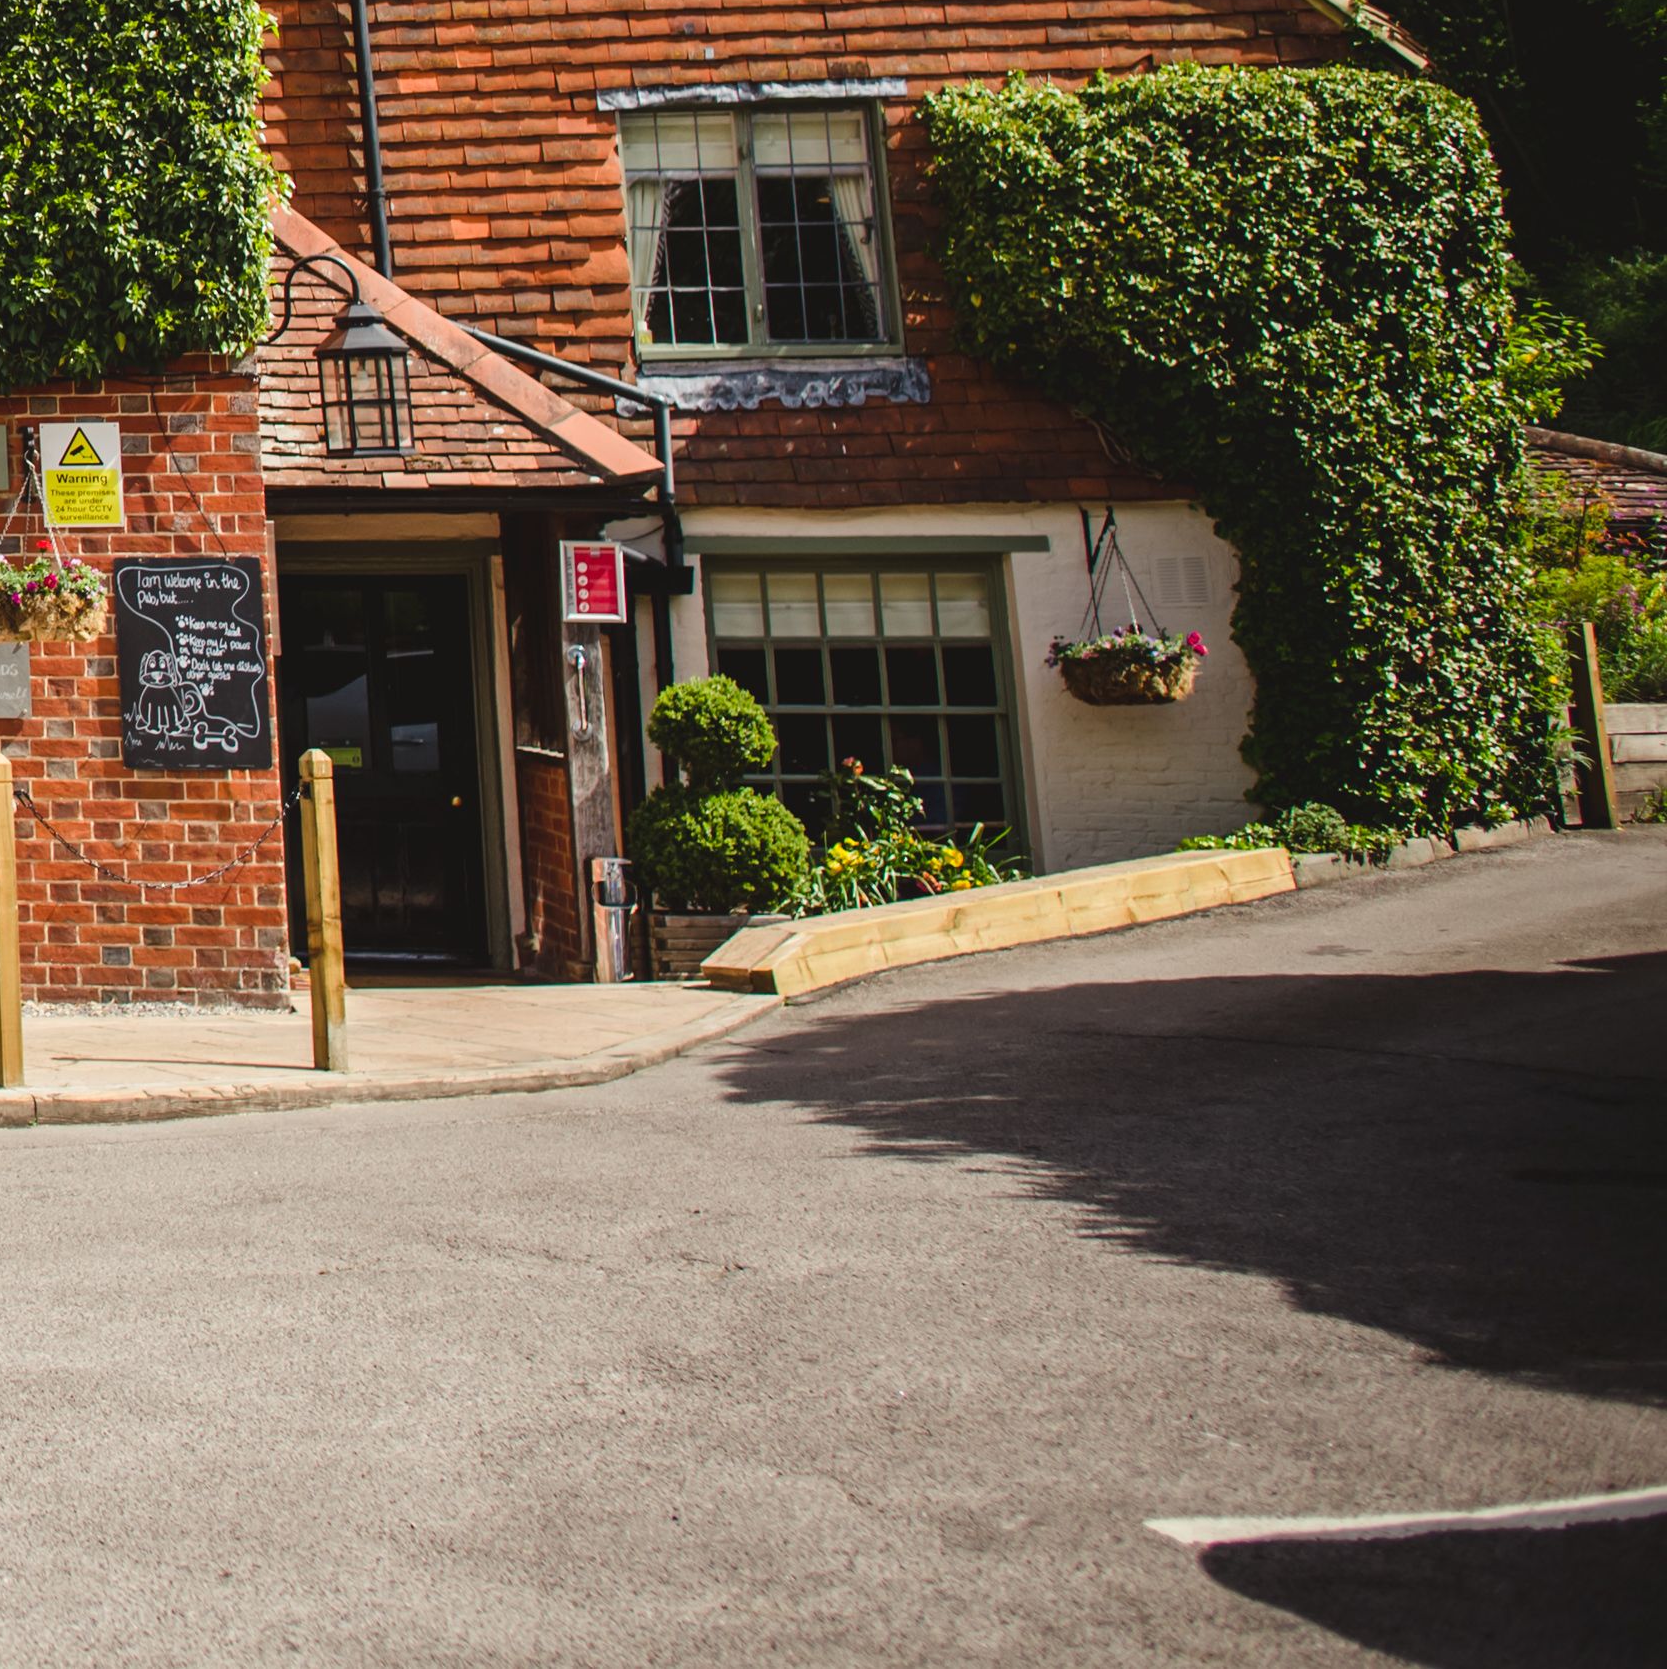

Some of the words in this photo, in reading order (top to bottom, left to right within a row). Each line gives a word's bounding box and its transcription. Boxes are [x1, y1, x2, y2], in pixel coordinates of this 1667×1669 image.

[56, 474, 108, 486] Warning
[77, 490, 116, 498] premises
[59, 513, 110, 521] surveillance
[142, 575, 162, 591] am
[204, 572, 220, 589] in
[221, 572, 241, 590] the
[189, 615, 205, 630] Keep
[206, 621, 217, 629] me
[218, 622, 228, 630] on
[189, 633, 206, 647] Keep
[206, 639, 218, 650] my
[219, 638, 228, 650] 4
[230, 640, 251, 651] paws
[179, 646, 190, 656] on
[212, 660, 222, 671] let
[224, 663, 235, 671] me
[187, 670, 205, 680] other
[208, 671, 231, 680] guests
